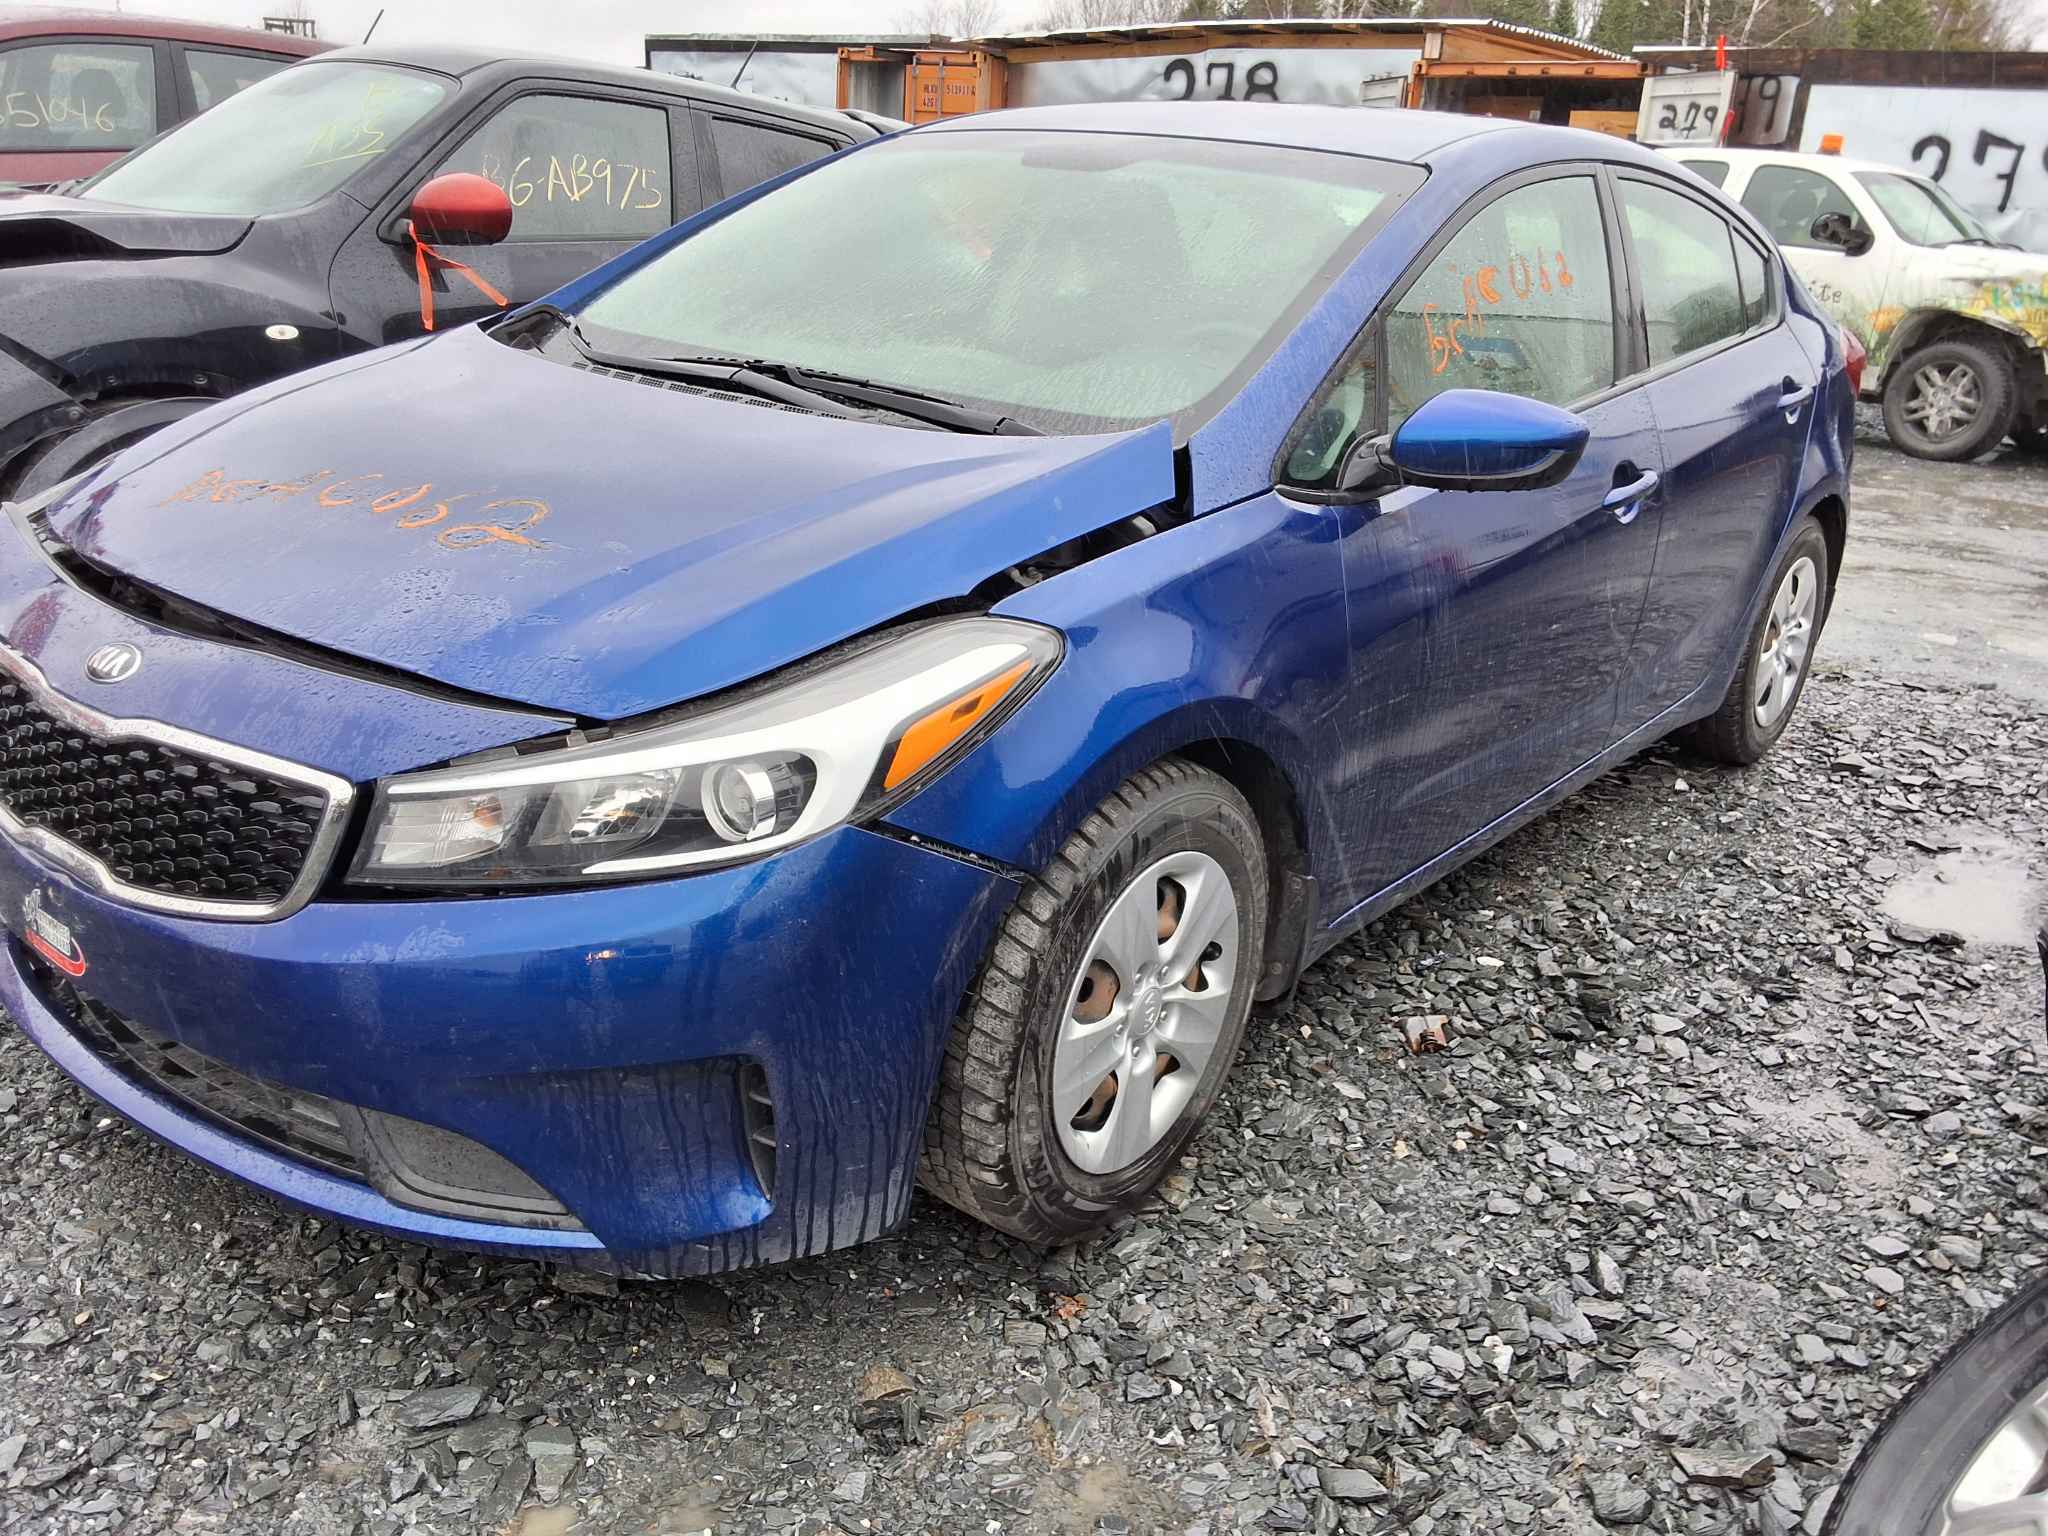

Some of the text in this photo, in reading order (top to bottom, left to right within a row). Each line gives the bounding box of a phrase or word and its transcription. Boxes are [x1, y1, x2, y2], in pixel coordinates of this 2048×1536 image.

[1163, 58, 1279, 101] 278
[1659, 101, 1719, 140] 279
[1912, 129, 2048, 213] 27
